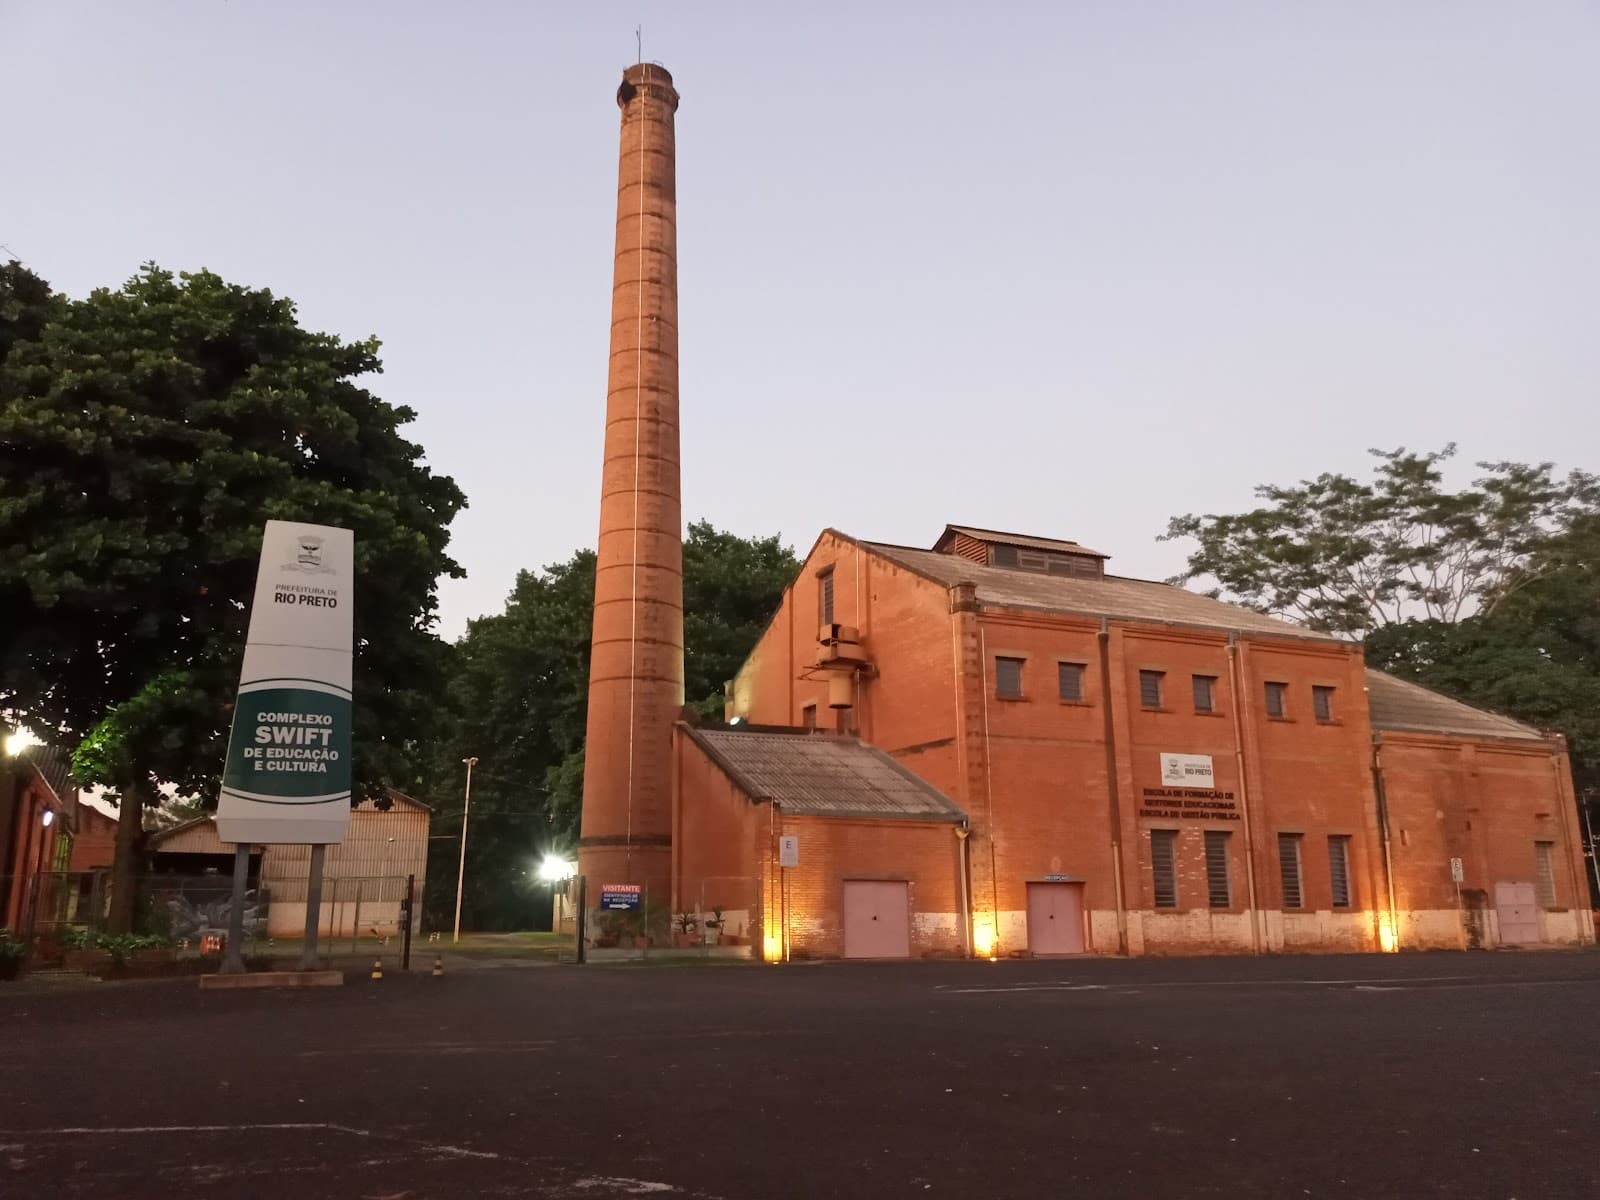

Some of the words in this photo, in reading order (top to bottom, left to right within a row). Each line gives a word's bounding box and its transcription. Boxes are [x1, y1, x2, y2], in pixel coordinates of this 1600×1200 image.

[275, 584, 325, 595] PREFEITURA
[274, 593, 296, 604] RIO
[298, 595, 337, 608] PRETO
[257, 712, 333, 725] COMPLEXO
[254, 726, 333, 746] SWIFT
[243, 747, 263, 758] DE
[266, 747, 339, 762] EDUCAÇÃO
[254, 761, 263, 771] E
[266, 761, 327, 773] CULTURA
[603, 885, 640, 893] VISITANTE
